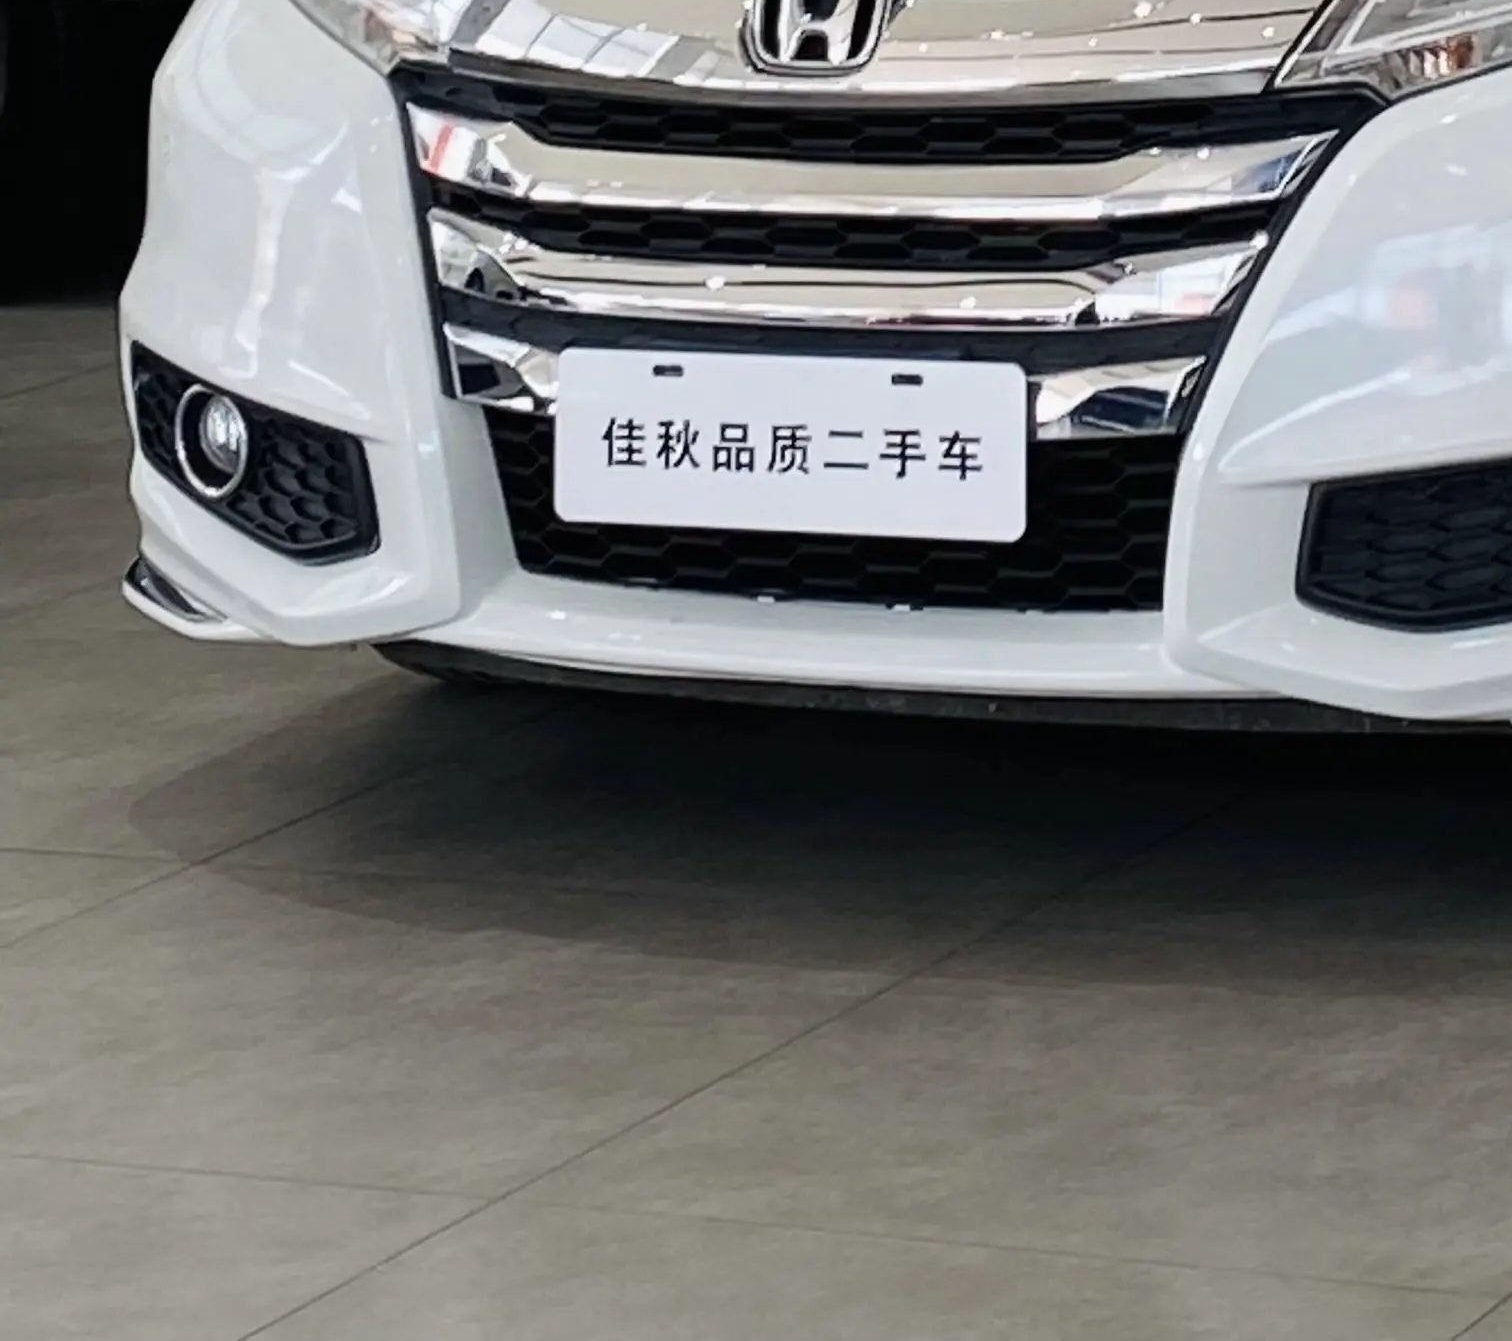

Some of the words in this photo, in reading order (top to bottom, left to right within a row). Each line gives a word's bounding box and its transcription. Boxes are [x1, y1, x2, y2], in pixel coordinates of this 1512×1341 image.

[602, 417, 984, 480] 佳秋品质二手车
